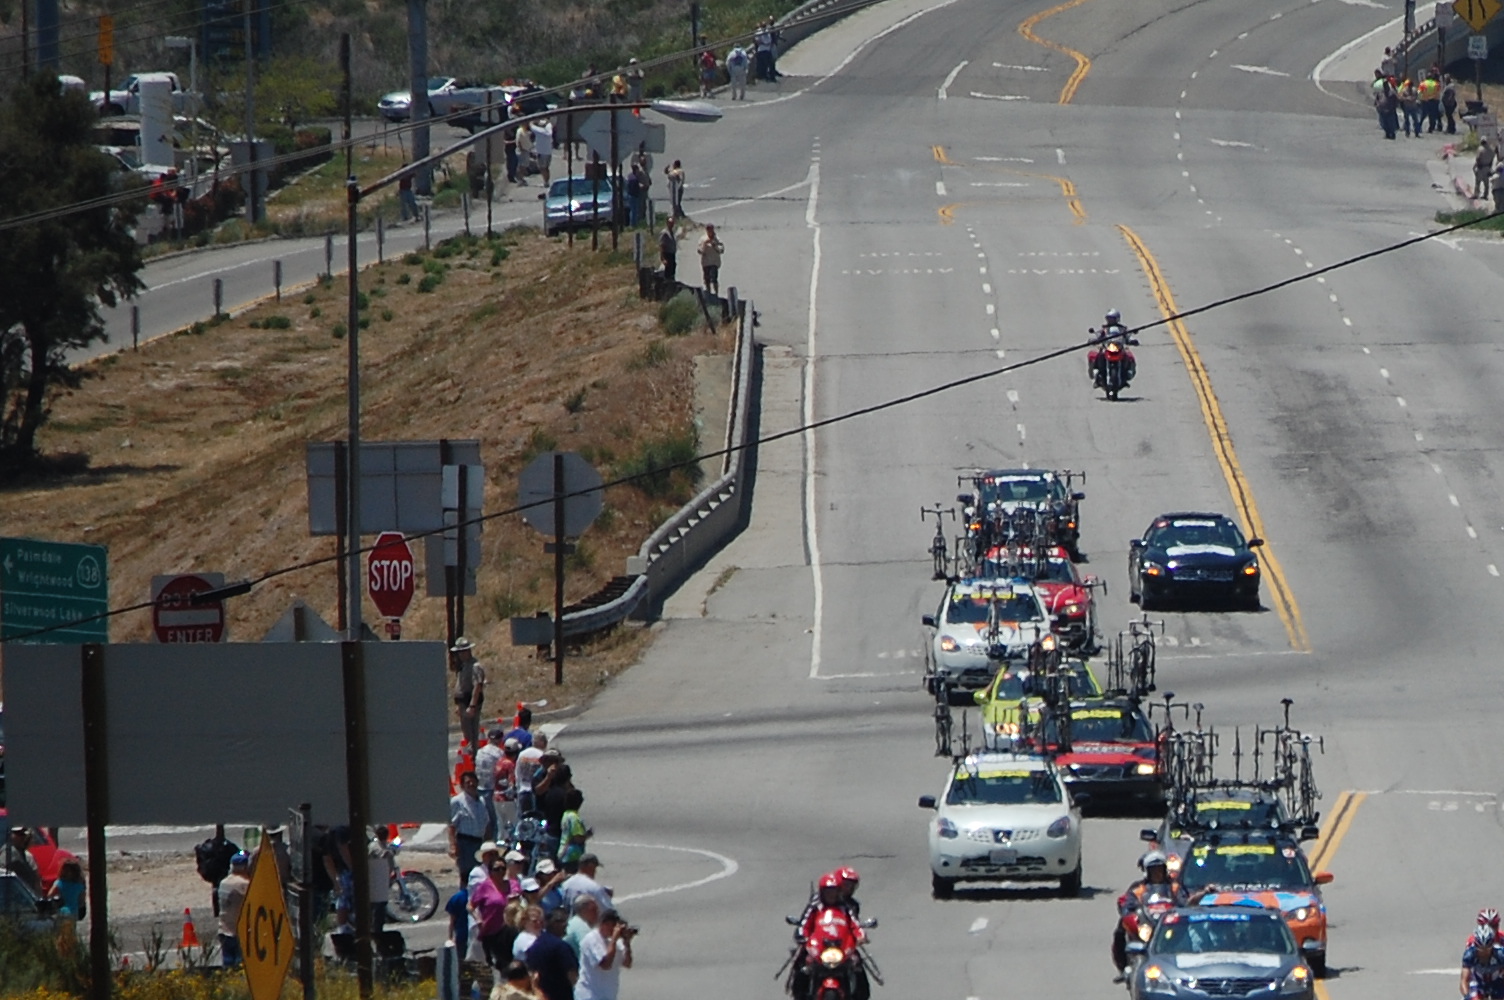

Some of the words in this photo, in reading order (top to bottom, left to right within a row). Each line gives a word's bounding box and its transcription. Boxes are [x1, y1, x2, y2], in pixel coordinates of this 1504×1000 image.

[17, 549, 62, 564] Palmdale
[18, 571, 73, 589] Wrightwood
[80, 565, 98, 583] 138
[371, 560, 412, 591] STOP
[4, 602, 56, 619] Silverwood
[59, 607, 83, 621] Lake
[167, 629, 214, 643] ENTER
[246, 904, 284, 967] ICY
